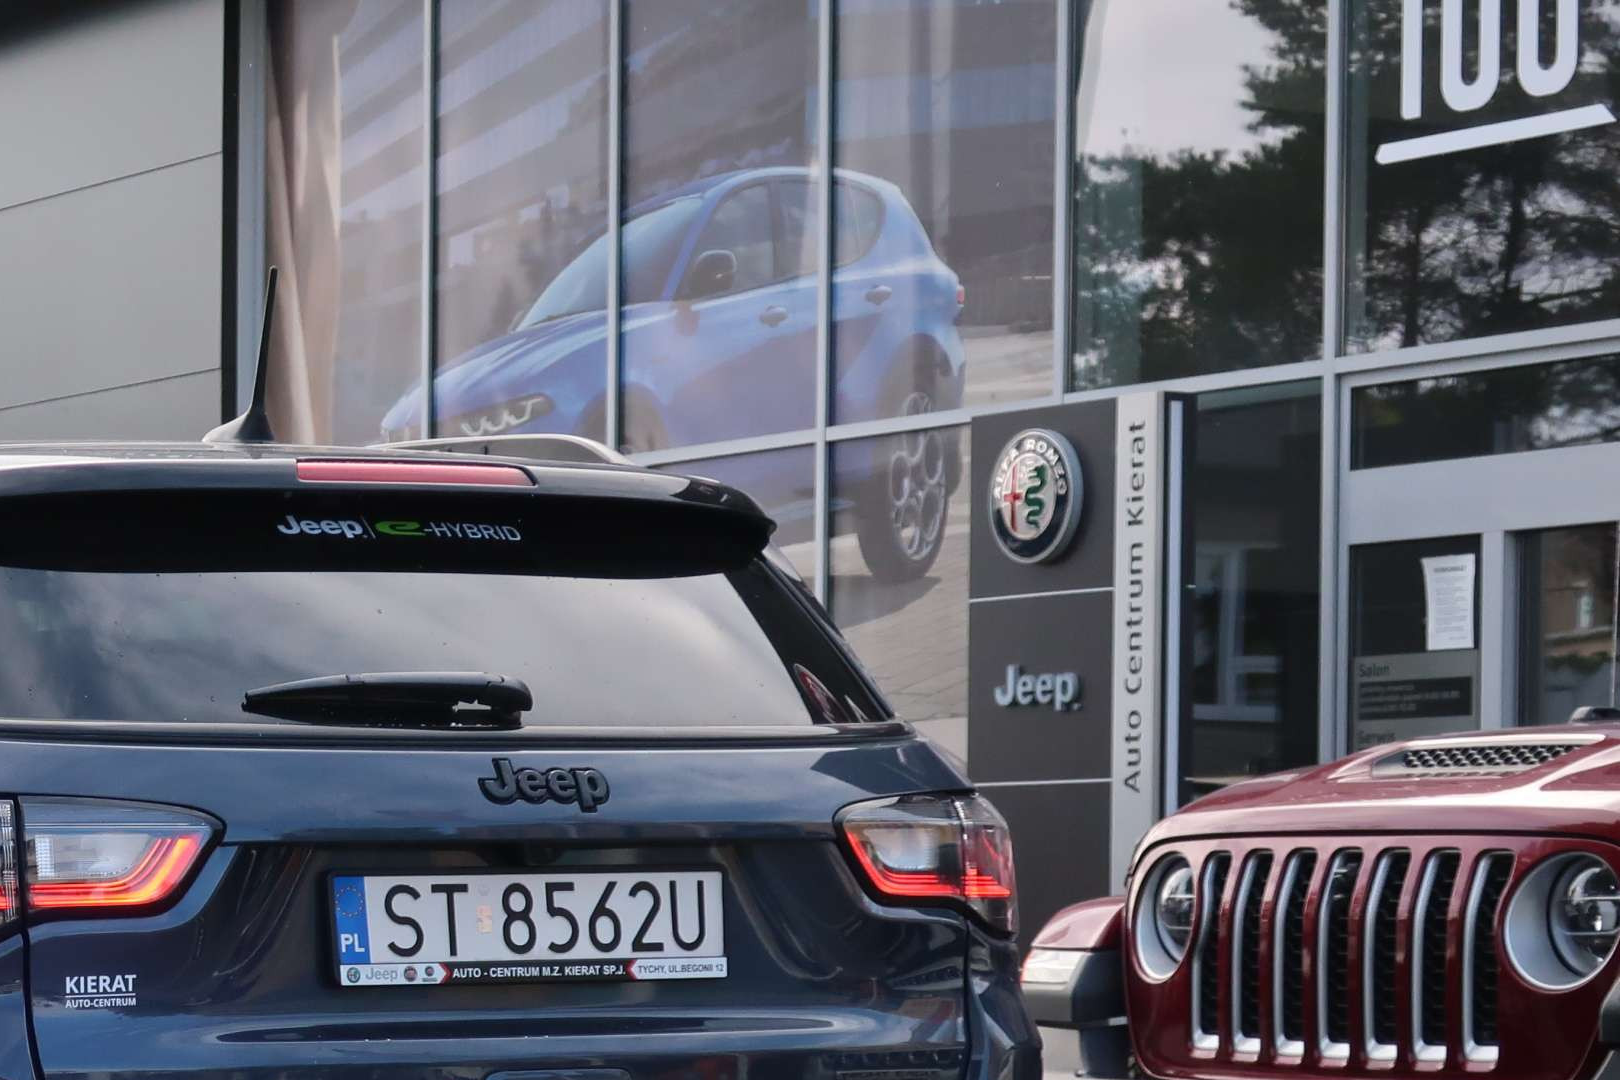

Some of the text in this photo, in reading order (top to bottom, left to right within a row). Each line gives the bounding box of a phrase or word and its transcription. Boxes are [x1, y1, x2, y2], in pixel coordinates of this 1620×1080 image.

[1023, 438, 1069, 496] ROMEO
[277, 514, 364, 539] Jeep
[1123, 420, 1146, 795] Auto Centrum Kierat
[993, 663, 1079, 712] Jeep
[477, 757, 611, 813] Jeep
[383, 879, 707, 958] ST 8562U
[339, 933, 366, 954] PL
[65, 974, 138, 994] KIERAT
[364, 966, 399, 983] Jeep
[452, 967, 482, 979] AUTO
[489, 966, 541, 978] CENTRUM
[542, 965, 563, 977] M.Z.
[564, 965, 601, 976] KIERAT
[65, 997, 137, 1009] AUTO-CENTRUM
